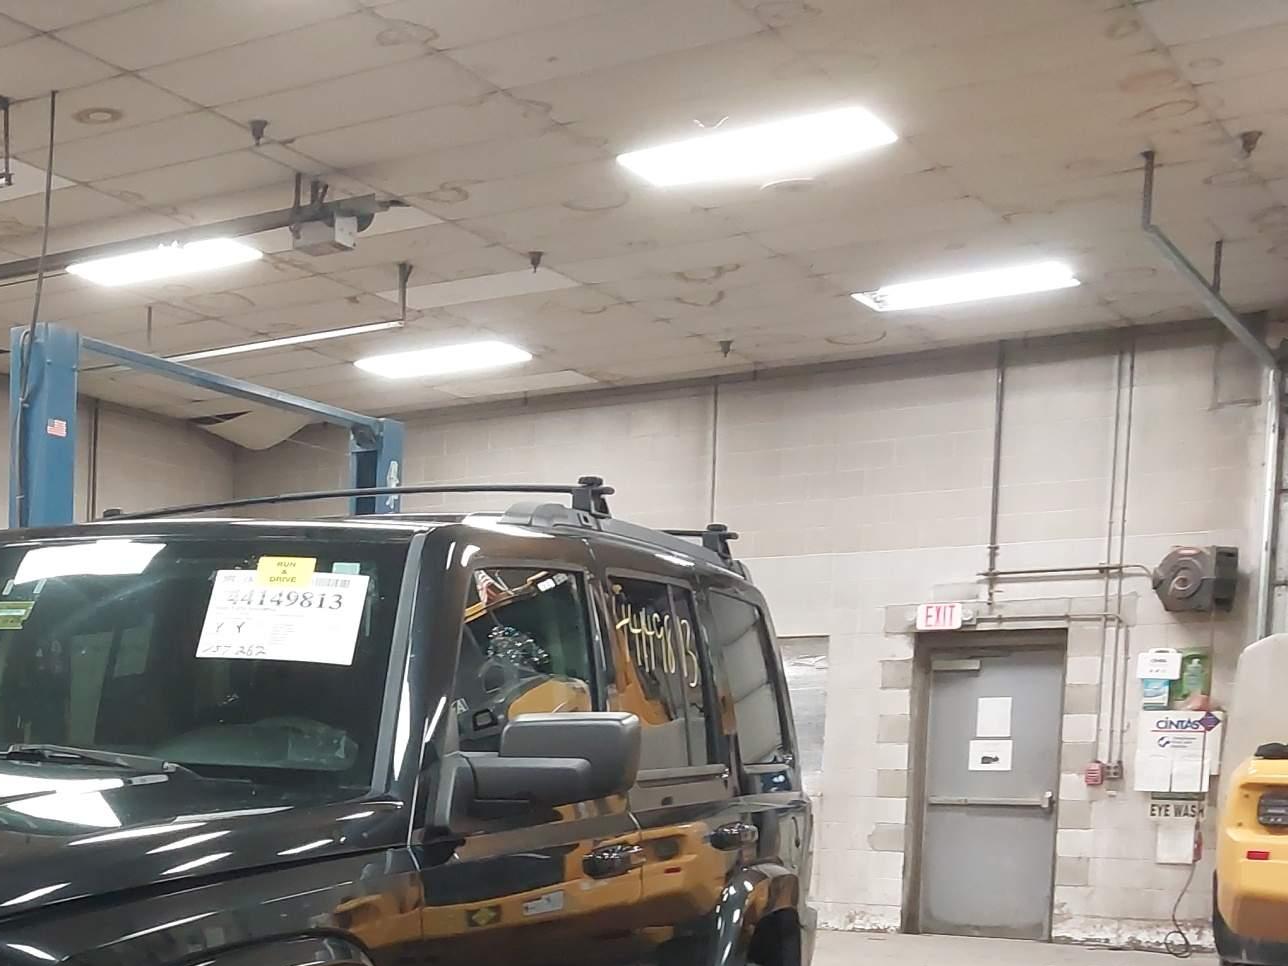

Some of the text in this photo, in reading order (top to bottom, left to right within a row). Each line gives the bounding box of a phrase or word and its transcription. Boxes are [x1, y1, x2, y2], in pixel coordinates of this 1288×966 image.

[925, 605, 955, 627] EXIT
[235, 645, 266, 656] 262
[1150, 804, 1170, 817] EYE
